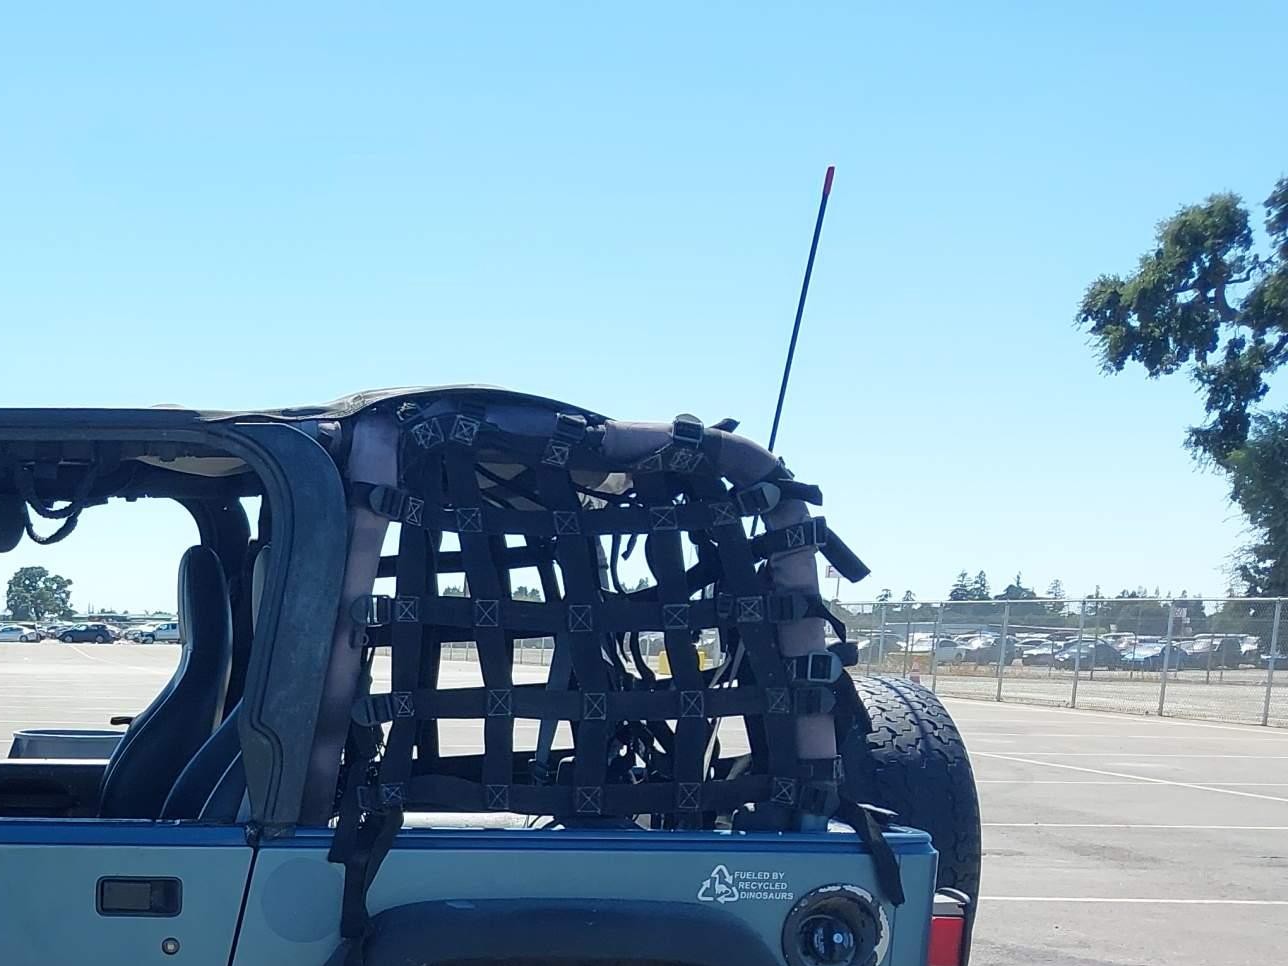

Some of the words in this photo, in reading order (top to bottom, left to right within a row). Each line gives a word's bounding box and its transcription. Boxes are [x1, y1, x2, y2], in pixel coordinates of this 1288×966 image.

[734, 871, 770, 879] FUELED
[738, 881, 788, 889] RECYCLED
[740, 891, 793, 899] DINOSAURS
